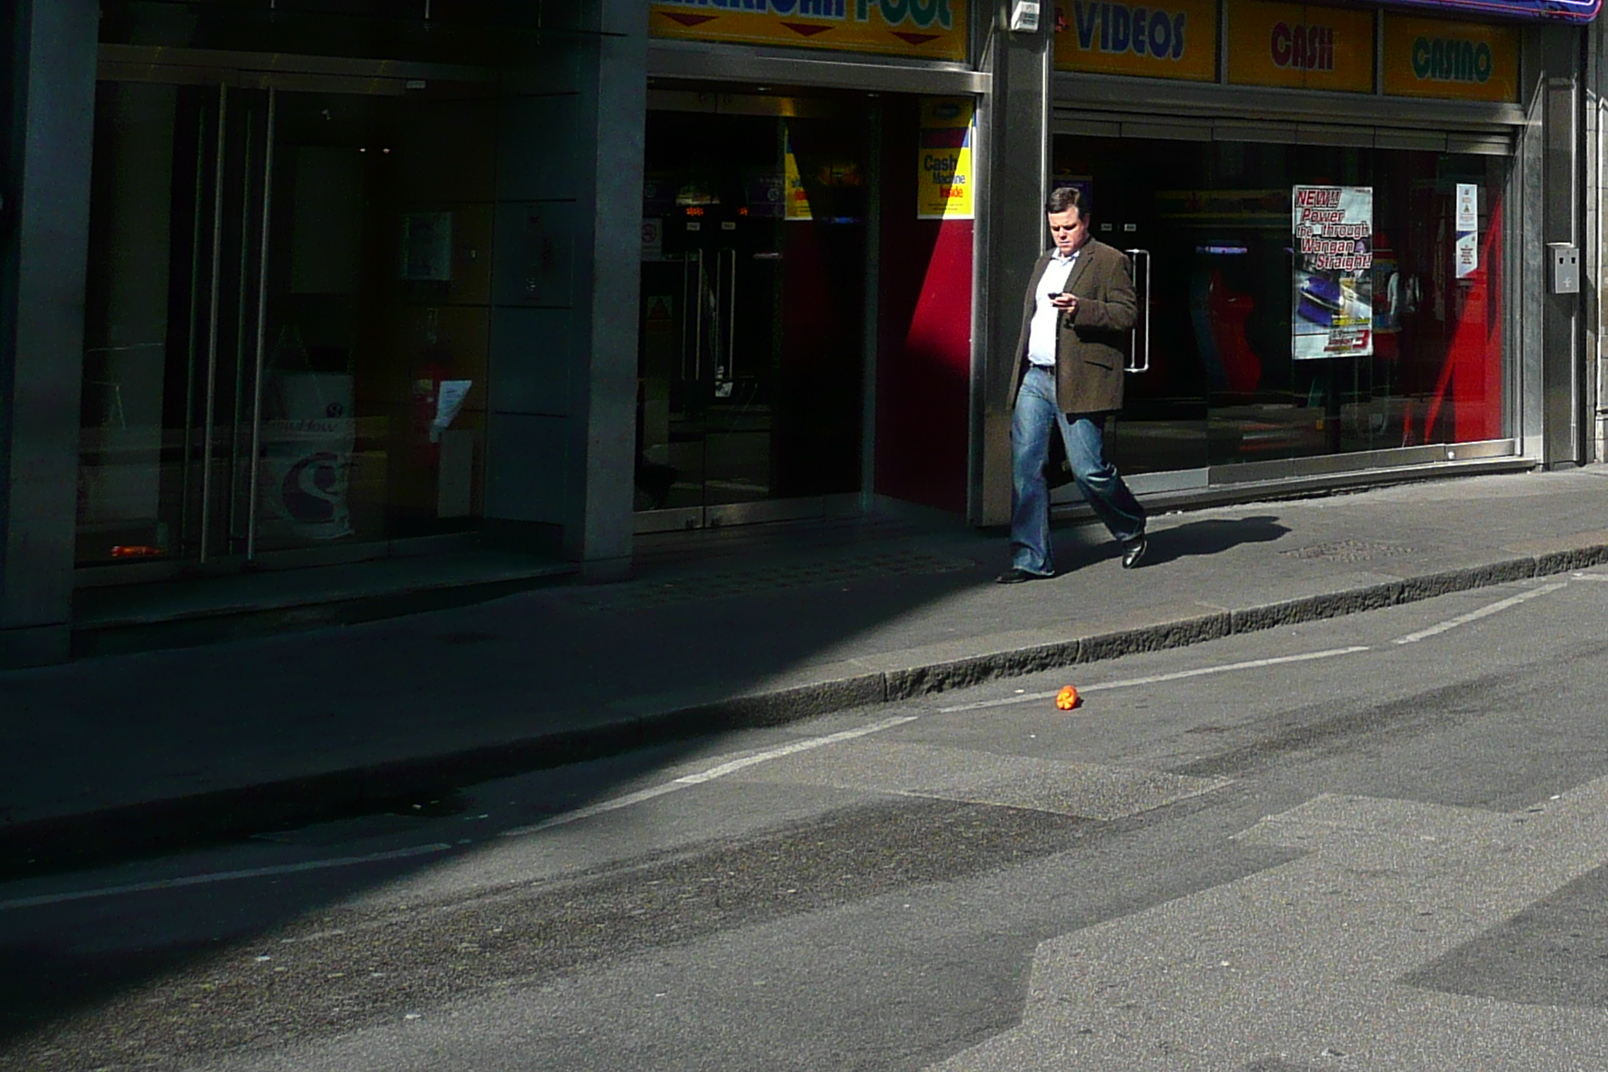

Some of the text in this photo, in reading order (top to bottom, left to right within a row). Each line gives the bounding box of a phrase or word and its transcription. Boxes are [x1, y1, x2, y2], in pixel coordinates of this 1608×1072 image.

[1073, 0, 1186, 61] VIDEOS
[1270, 20, 1335, 71] CASH
[1410, 35, 1493, 85] CASINO
[924, 154, 957, 172] Cash
[933, 172, 966, 185] Machine
[1302, 208, 1344, 223] Power
[1320, 222, 1370, 239] through
[1301, 237, 1354, 254] Wangan
